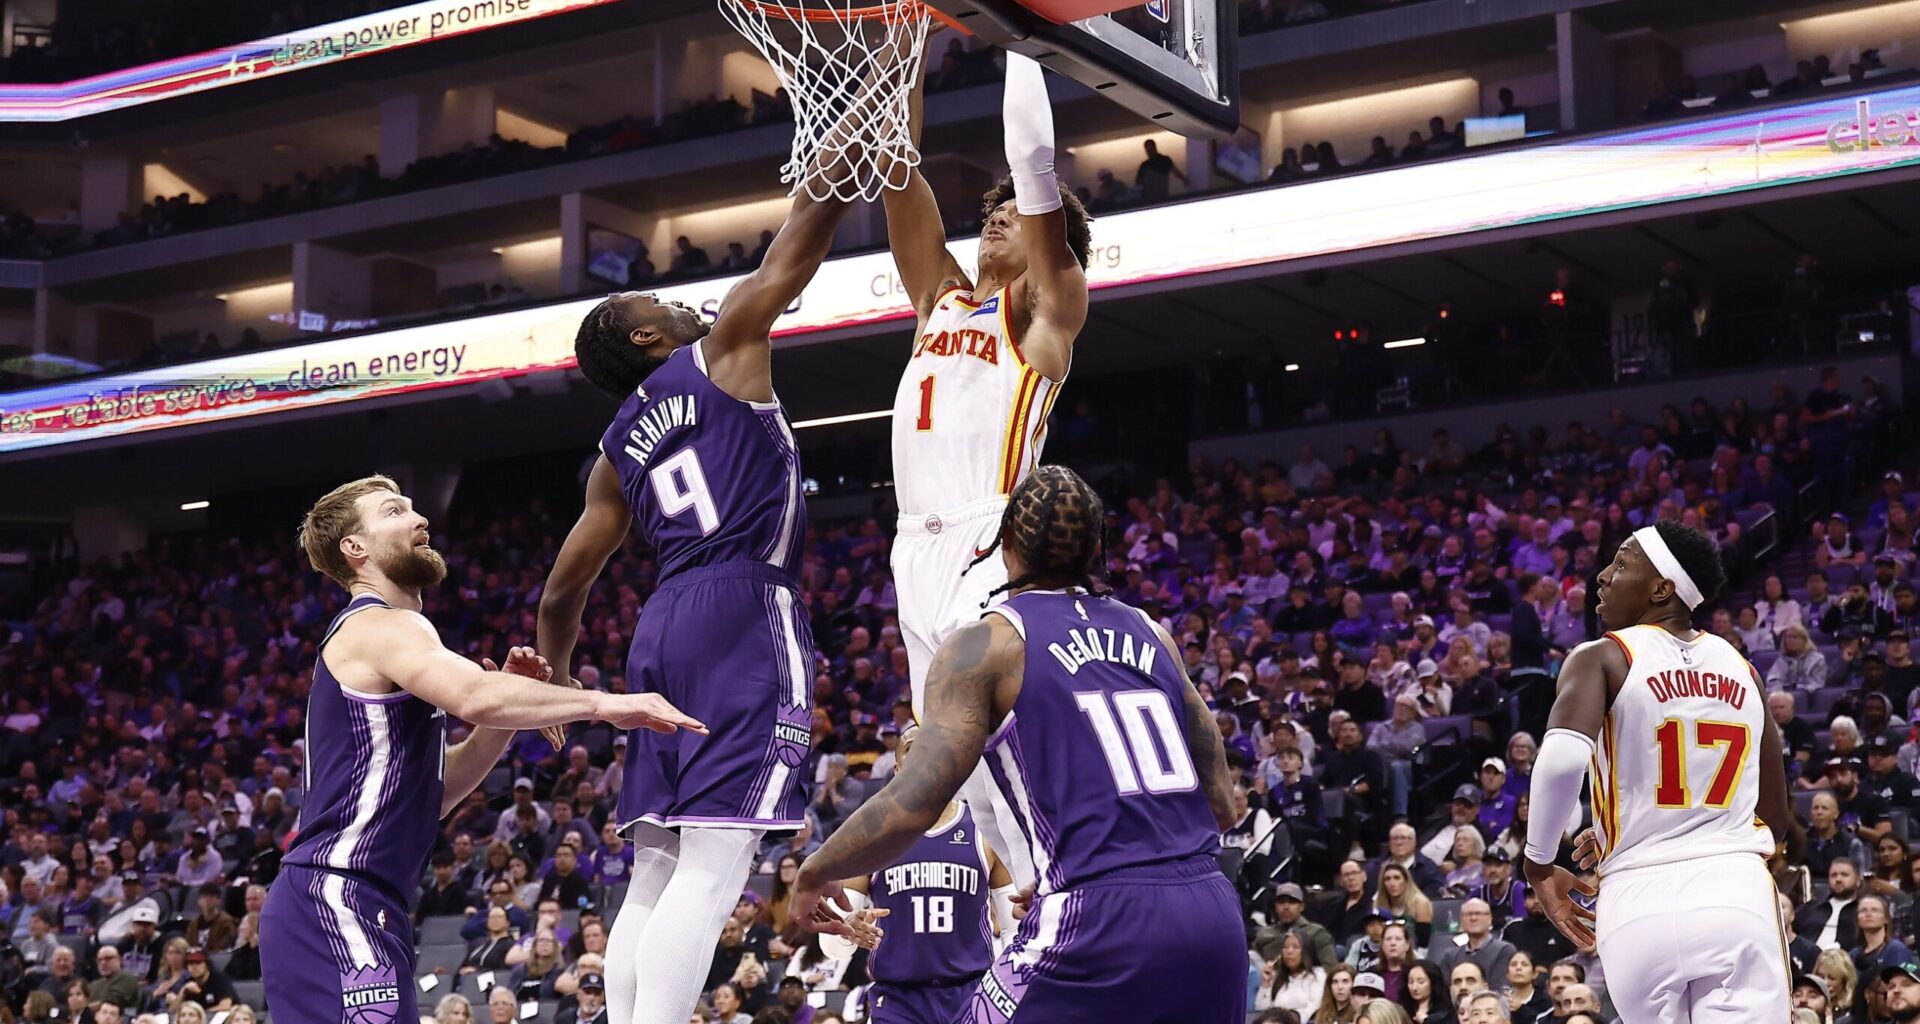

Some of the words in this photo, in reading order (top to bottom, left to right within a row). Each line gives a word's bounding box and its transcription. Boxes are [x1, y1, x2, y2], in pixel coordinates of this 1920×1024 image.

[271, 37, 334, 66] clean
[343, 17, 420, 57] power
[431, 0, 531, 39] promise
[1828, 100, 1920, 153] cle
[63, 385, 156, 428] reliable
[164, 376, 257, 412] service
[288, 359, 357, 391] clean
[369, 344, 467, 377] energy
[916, 373, 936, 432] 1
[624, 395, 696, 466] ACHIUWA
[649, 445, 721, 538] 9
[1048, 627, 1157, 676] DeROZAN
[1647, 669, 1746, 710] OKONGWU
[775, 724, 811, 747] KINGS
[1072, 688, 1199, 797] 10
[1654, 717, 1751, 809] 17
[884, 862, 979, 896] SACRAMENTO
[911, 896, 954, 933] 18
[342, 987, 400, 1008] KINGS
